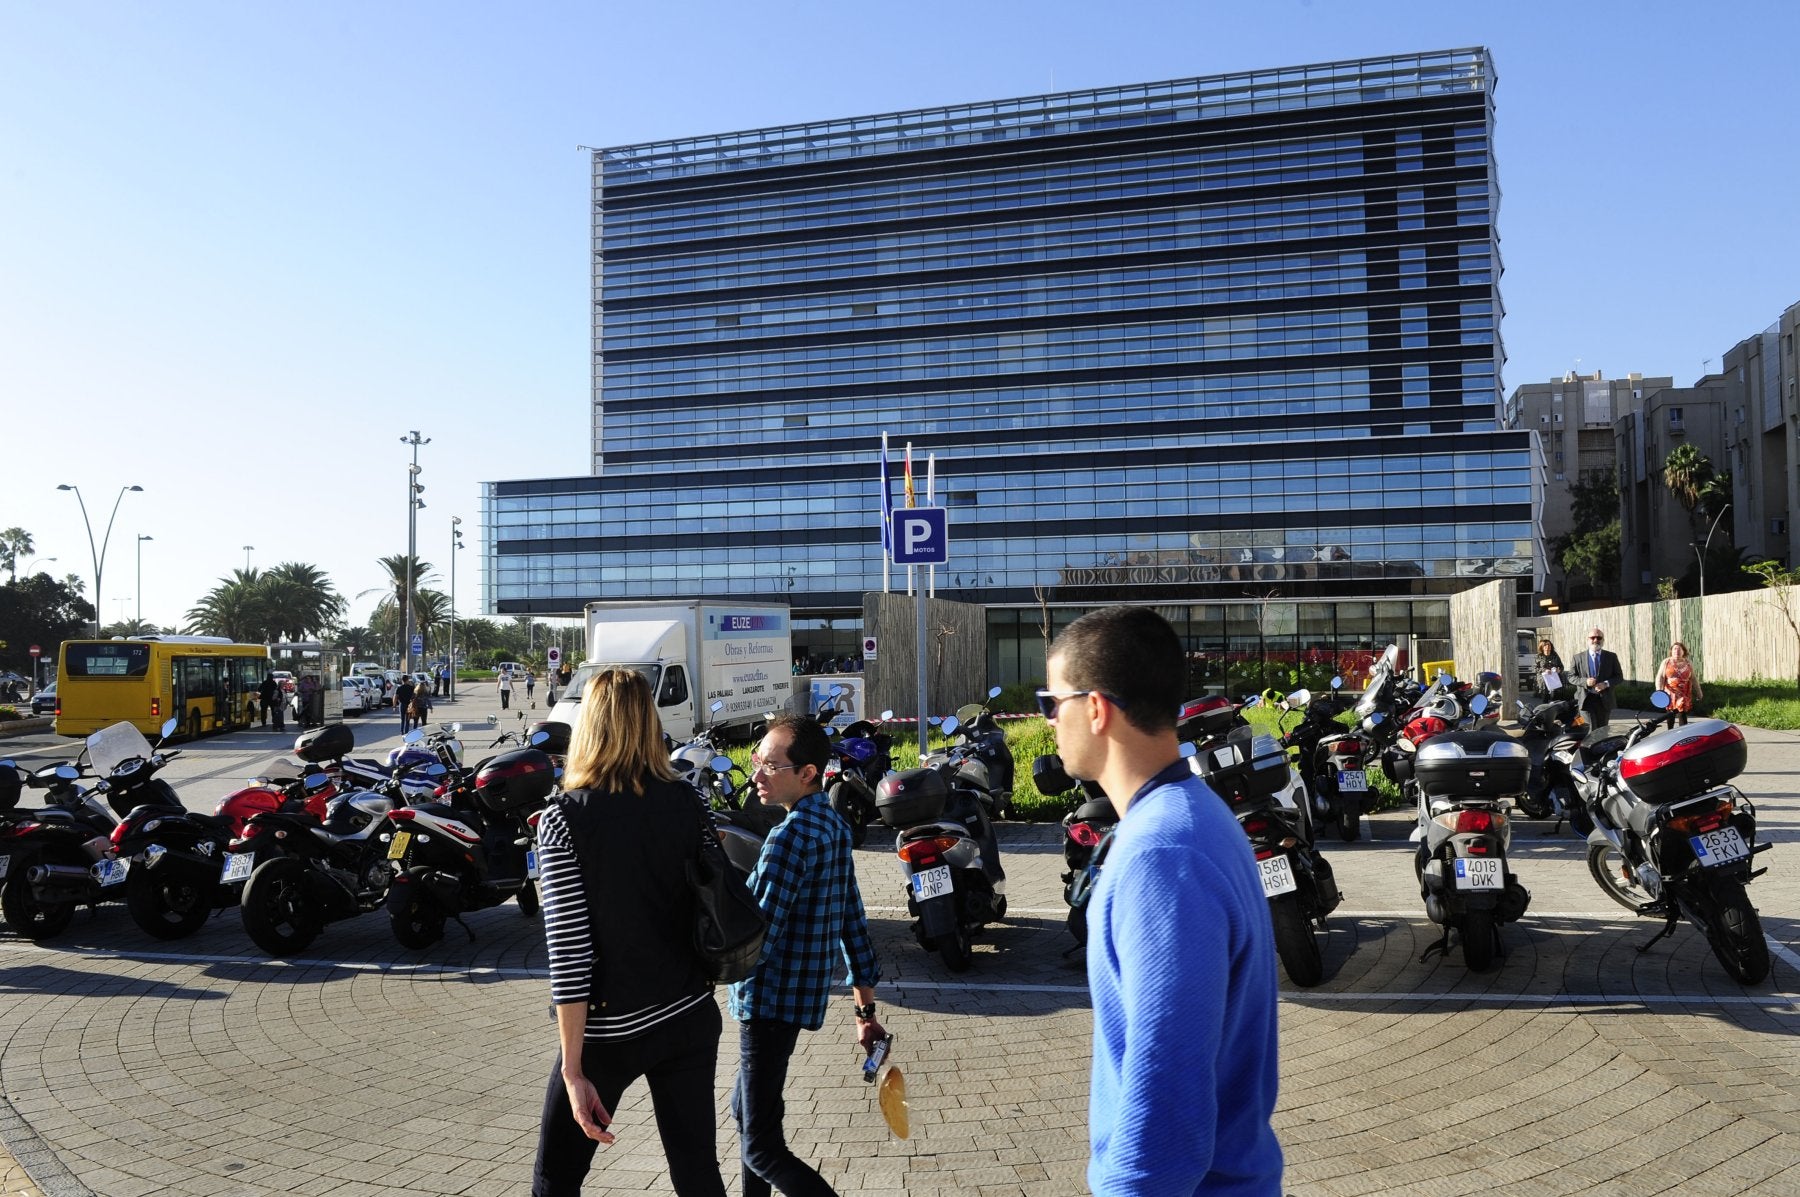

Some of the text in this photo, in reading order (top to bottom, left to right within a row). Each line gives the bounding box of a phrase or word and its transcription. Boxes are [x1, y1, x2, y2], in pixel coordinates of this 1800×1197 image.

[905, 519, 932, 555] P
[724, 642, 743, 656] Obras
[748, 642, 774, 655] Reformas
[707, 681, 790, 699] LAS PALMAS LANZAROTE TENERIFE
[1701, 828, 1739, 849] 2633
[1711, 842, 1740, 861] FKV
[1257, 857, 1288, 876] 1580
[1467, 860, 1497, 873] 4018
[920, 868, 949, 886] 7035
[1263, 873, 1290, 891] HSH
[1471, 873, 1495, 887] DVK
[922, 881, 943, 898] DNP
